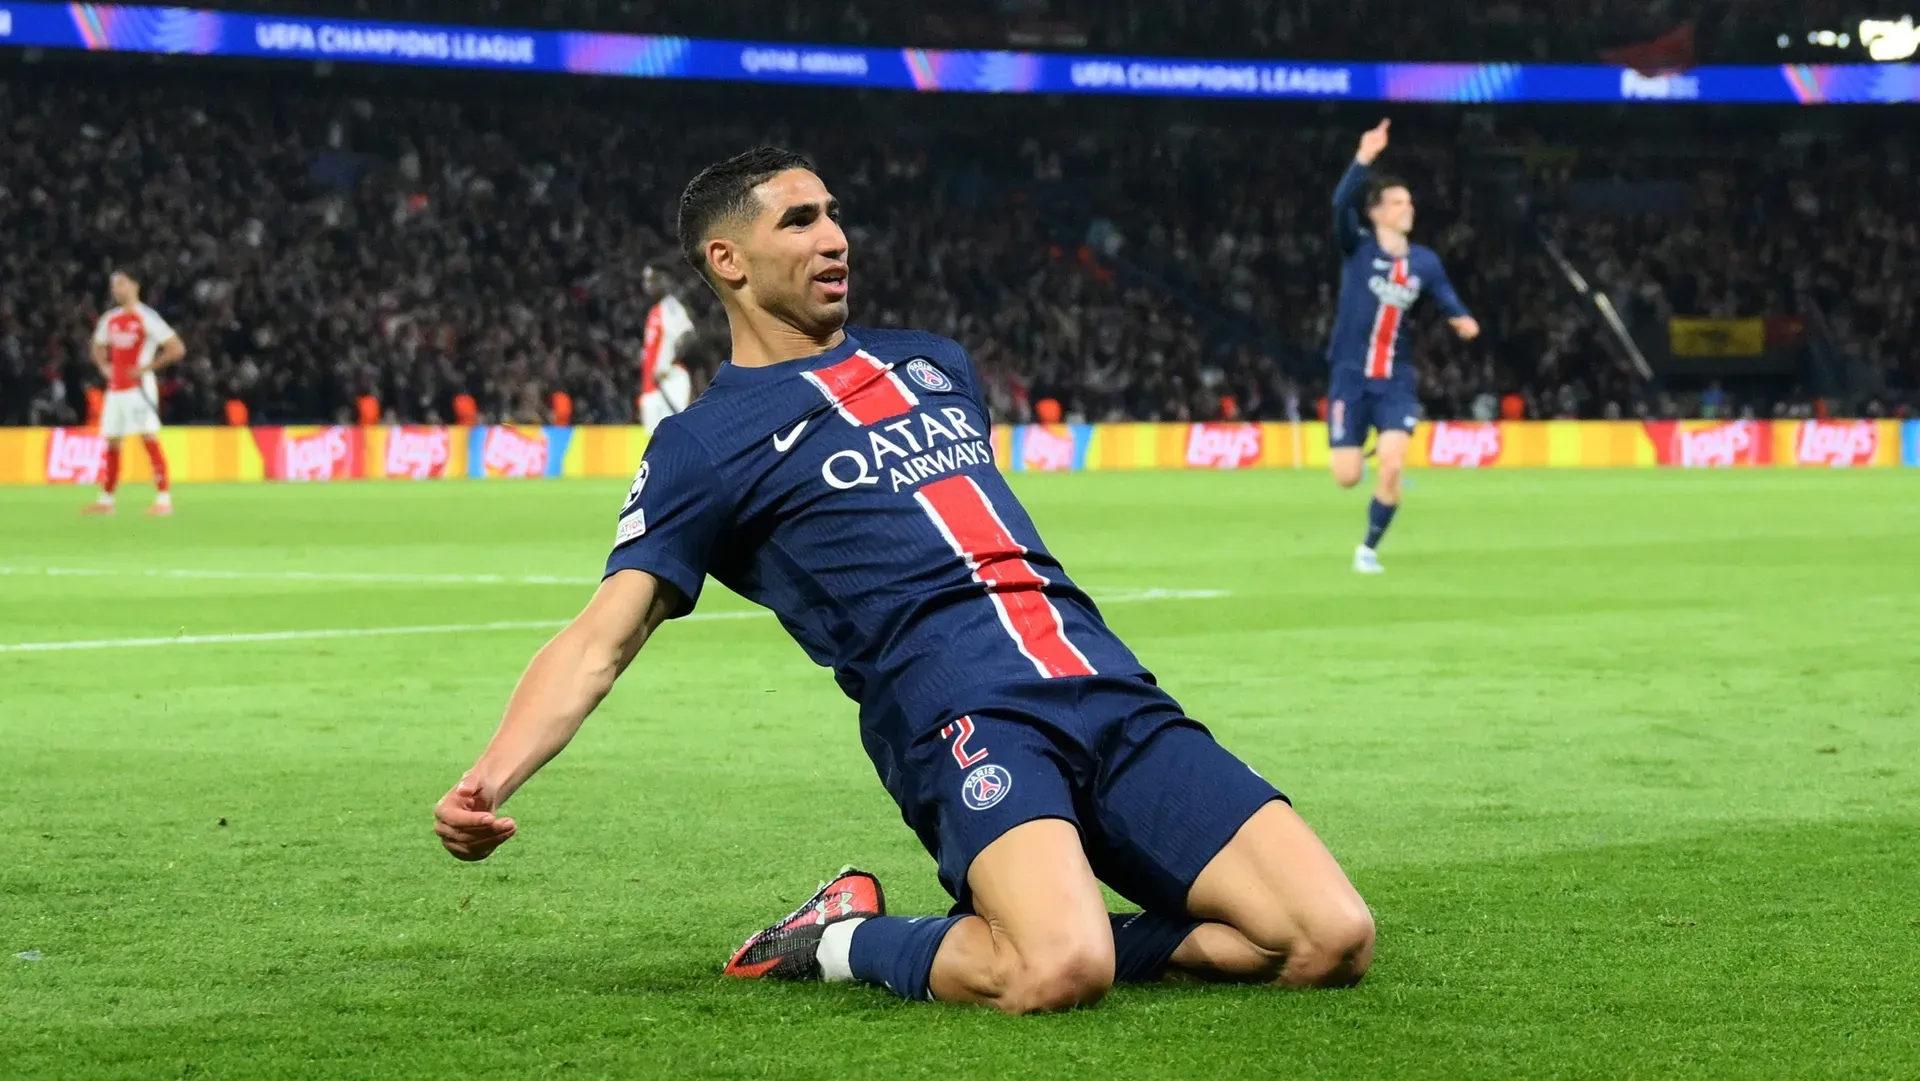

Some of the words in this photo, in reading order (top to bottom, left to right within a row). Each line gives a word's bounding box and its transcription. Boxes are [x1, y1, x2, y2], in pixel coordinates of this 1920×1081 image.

[255, 22, 316, 50] UEFA
[317, 24, 448, 60] CHAMPIONS
[450, 34, 535, 63] LEAGUE
[821, 407, 981, 490] QATAR
[889, 440, 991, 493] AIRWAYS
[941, 715, 989, 769] 2
[966, 767, 995, 788] PARIS
